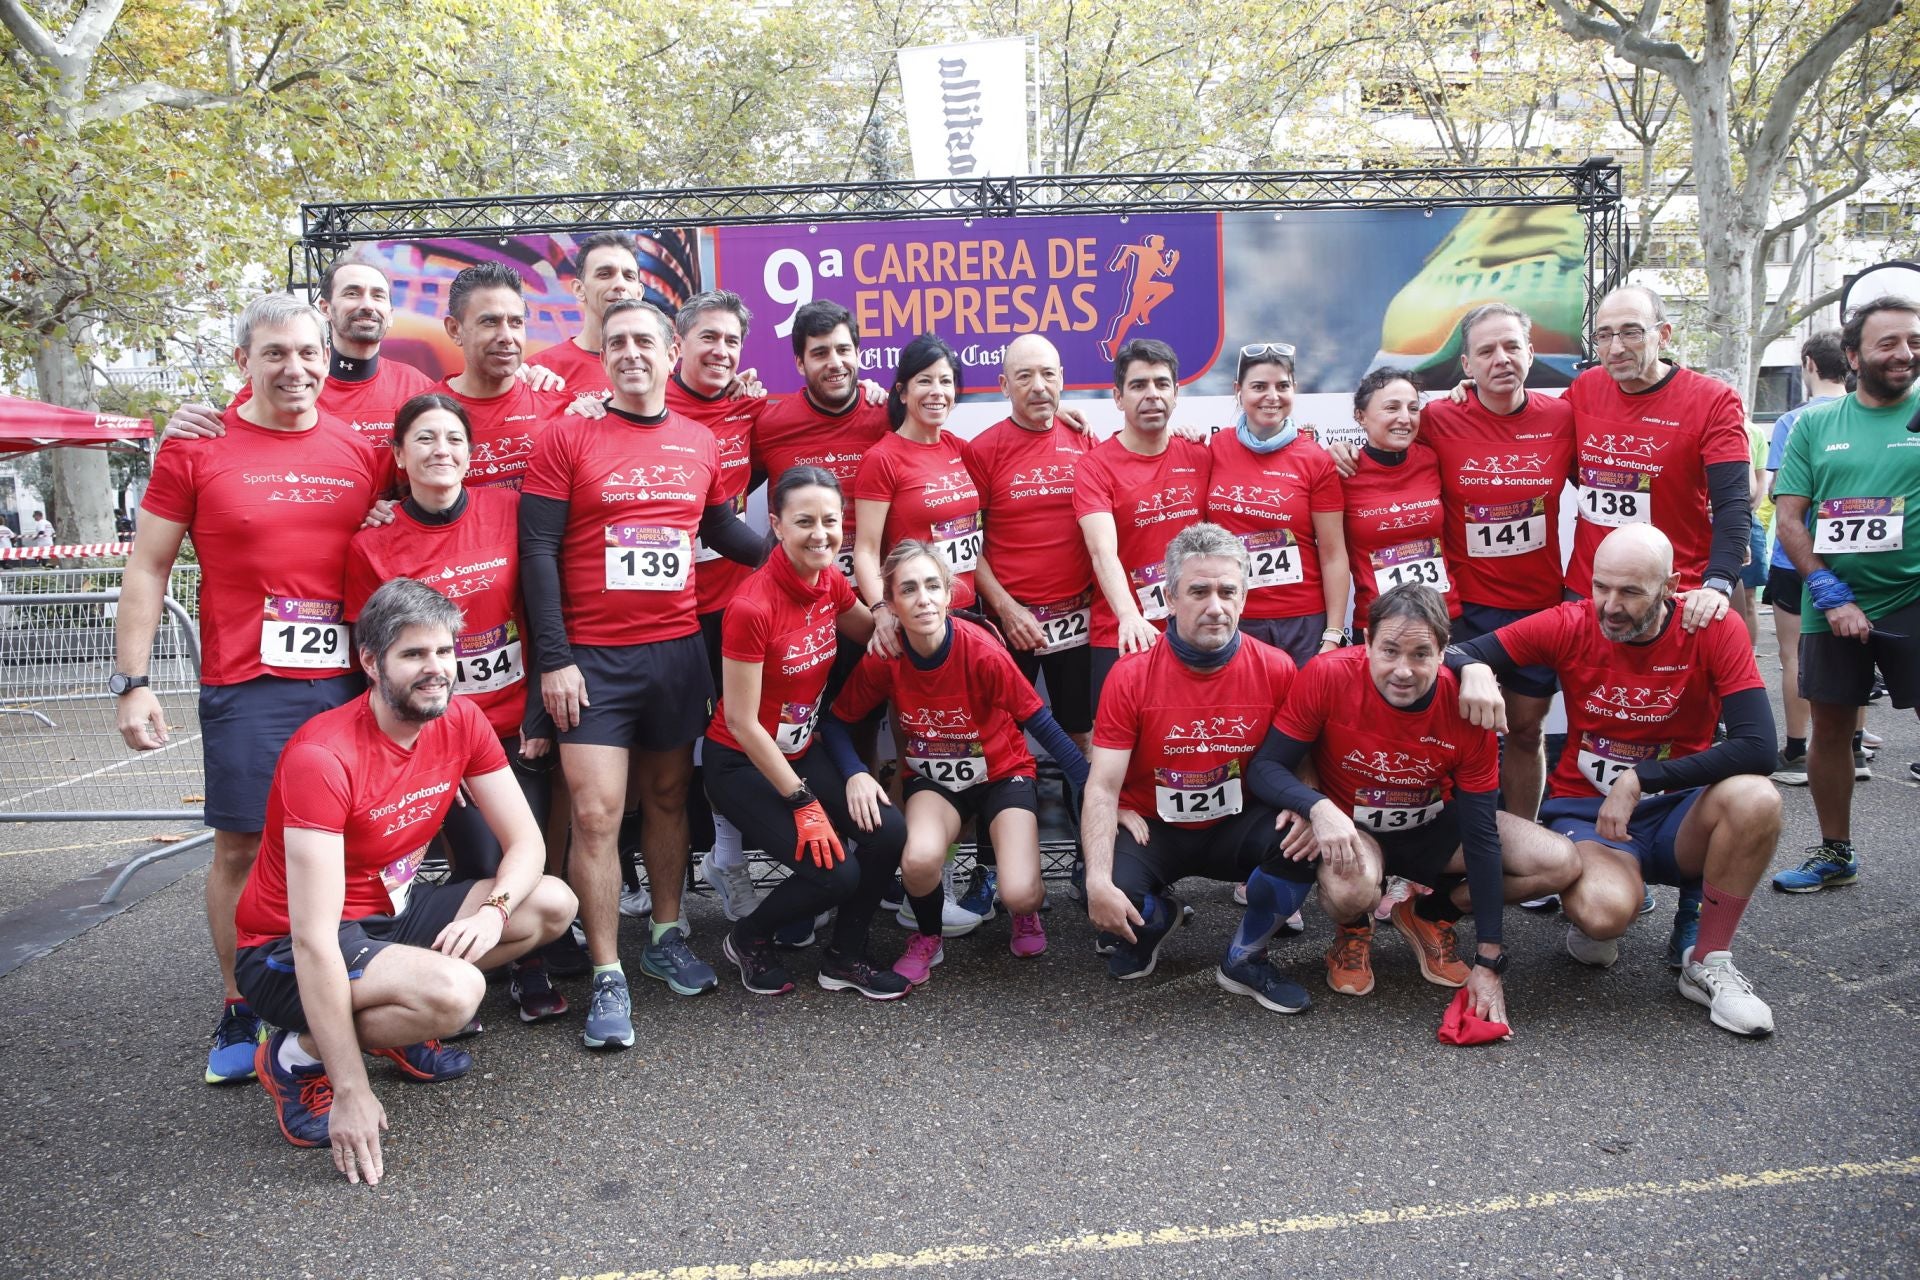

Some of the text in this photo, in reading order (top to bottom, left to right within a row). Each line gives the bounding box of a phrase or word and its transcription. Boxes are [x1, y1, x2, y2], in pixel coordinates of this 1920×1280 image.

[853, 239, 1037, 284] CARRERA
[1047, 238, 1098, 278] DE
[857, 283, 1099, 338] EMPRESAS
[961, 344, 1009, 367] Cast
[362, 421, 394, 431] Santan
[1326, 427, 1366, 436] Ayuntamien
[1825, 443, 1850, 452] JAKO
[793, 452, 863, 467] Sports Santa
[1580, 449, 1664, 473] Sports Santander
[243, 473, 355, 488] Sports Santander
[464, 468, 483, 481] orts
[1459, 475, 1553, 486] Sports Santander
[601, 489, 697, 504] Sports Santander
[924, 496, 953, 508] Sports
[1010, 488, 1038, 499] Sports
[1586, 490, 1637, 517] 138
[1207, 500, 1293, 521] Sports Santander
[1357, 506, 1389, 518] Sports
[1134, 515, 1160, 528] Sports
[1828, 518, 1887, 543] 378
[1478, 520, 1531, 546] 141
[946, 534, 981, 564] 130
[455, 557, 508, 577] Santander
[620, 550, 680, 578] 139
[1388, 561, 1439, 585] 133
[297, 606, 331, 617] EMPRESAS
[1042, 612, 1088, 644] 122
[278, 625, 338, 655] 129
[457, 649, 512, 683] 134
[782, 660, 811, 676] Sports
[1584, 699, 1613, 718] Sports
[1163, 742, 1255, 756] Sports Santander
[918, 760, 975, 782] 126
[1169, 785, 1226, 813] 121
[369, 804, 397, 821] Sports
[1368, 808, 1427, 828] 131
